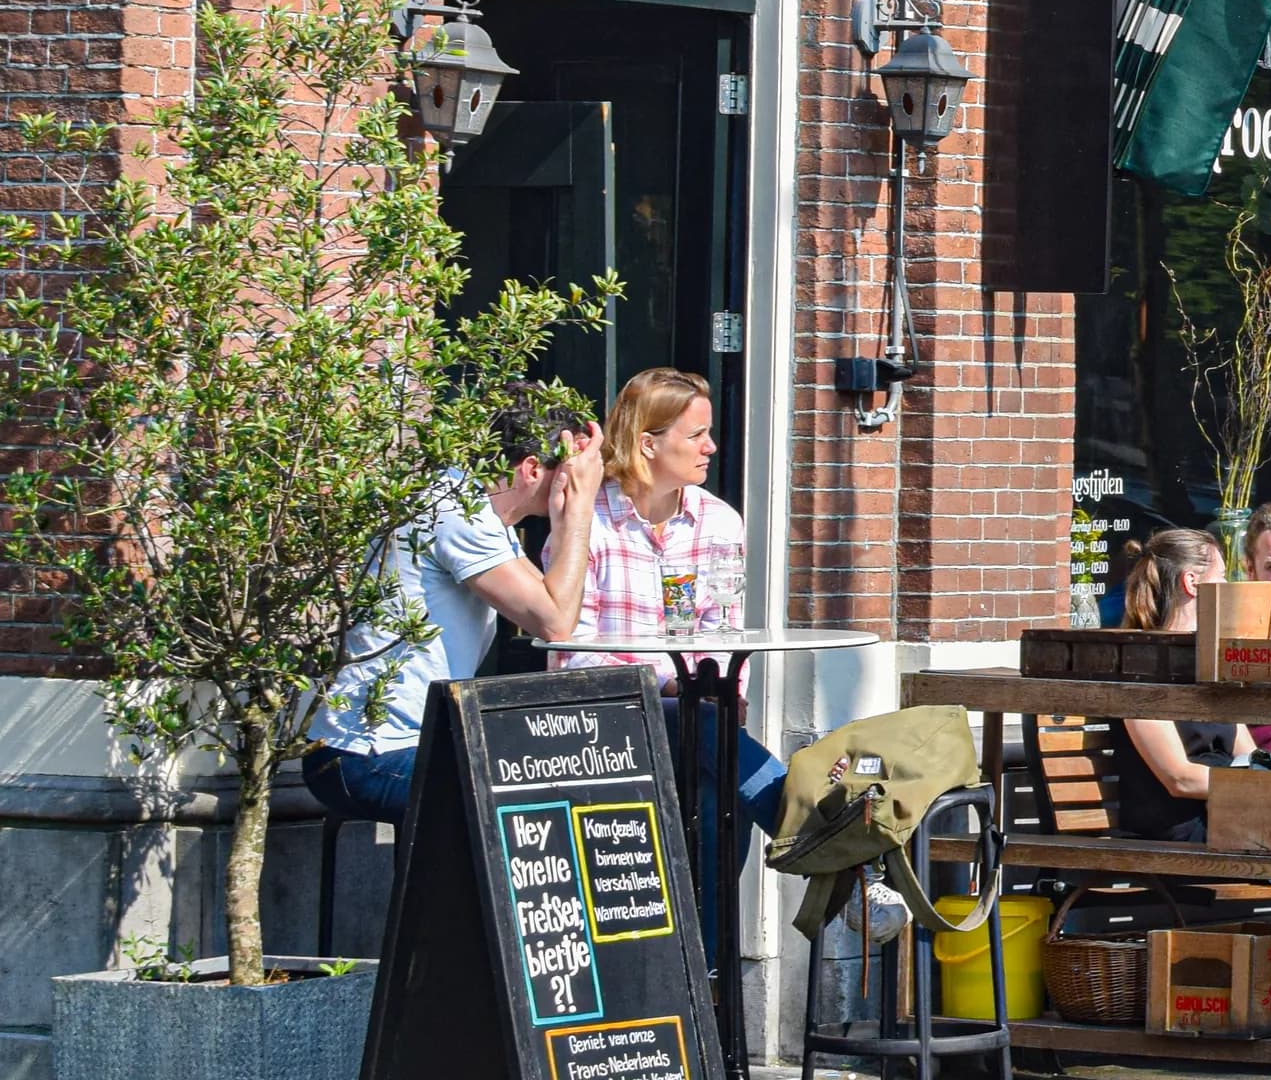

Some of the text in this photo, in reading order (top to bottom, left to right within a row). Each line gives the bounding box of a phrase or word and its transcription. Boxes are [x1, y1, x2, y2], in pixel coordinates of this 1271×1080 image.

[524, 710, 599, 744] Welkom bij
[498, 758, 523, 782] De
[523, 754, 583, 780] Groene
[512, 815, 552, 851] Hey
[583, 817, 647, 845] Kom gezellig
[510, 855, 572, 890] Snelle
[594, 848, 653, 867] binnen voor
[525, 932, 590, 977] biertje
[551, 974, 577, 1013] ?!
[568, 1030, 656, 1055] Geniet van onze
